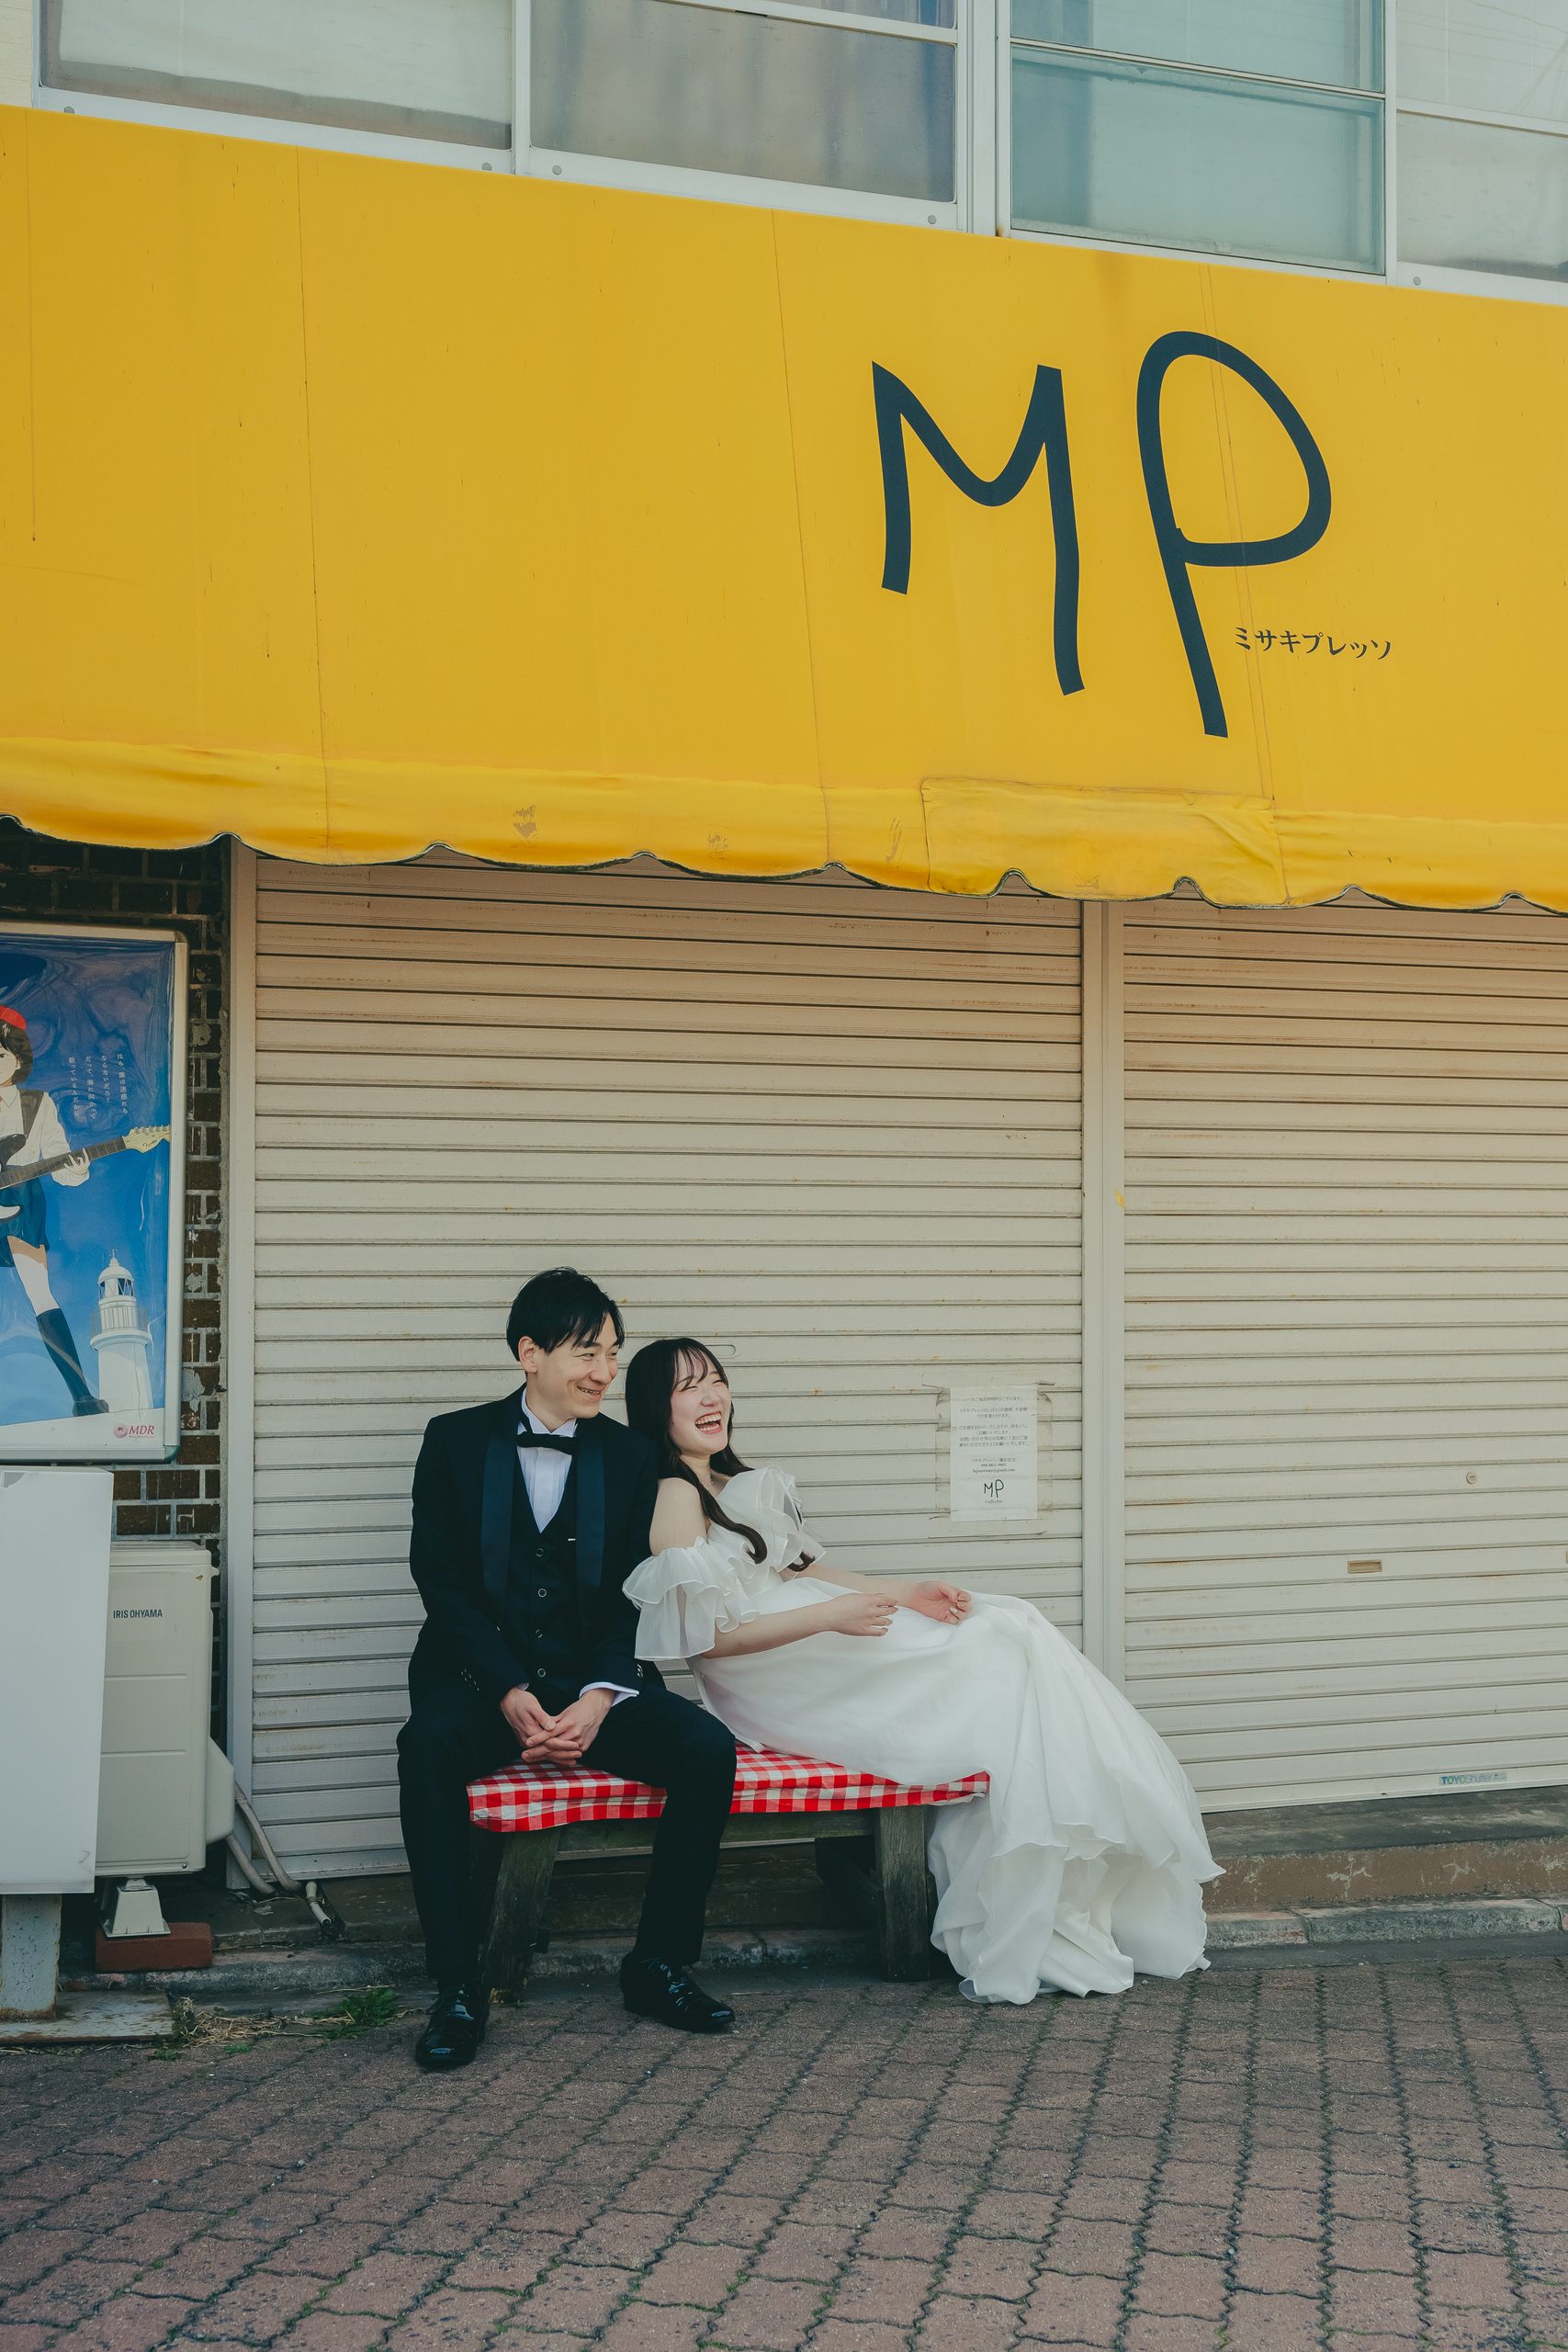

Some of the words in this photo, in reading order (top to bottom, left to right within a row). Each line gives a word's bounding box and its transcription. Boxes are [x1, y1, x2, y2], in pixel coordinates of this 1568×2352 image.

[872, 331, 1332, 739] MP
[1235, 627, 1392, 660] ミサキプレッソ
[129, 1425, 155, 1435] MDR
[984, 1479, 1005, 1498] MP
[113, 1610, 129, 1619] IRIS
[130, 1609, 164, 1618] OHYAMA
